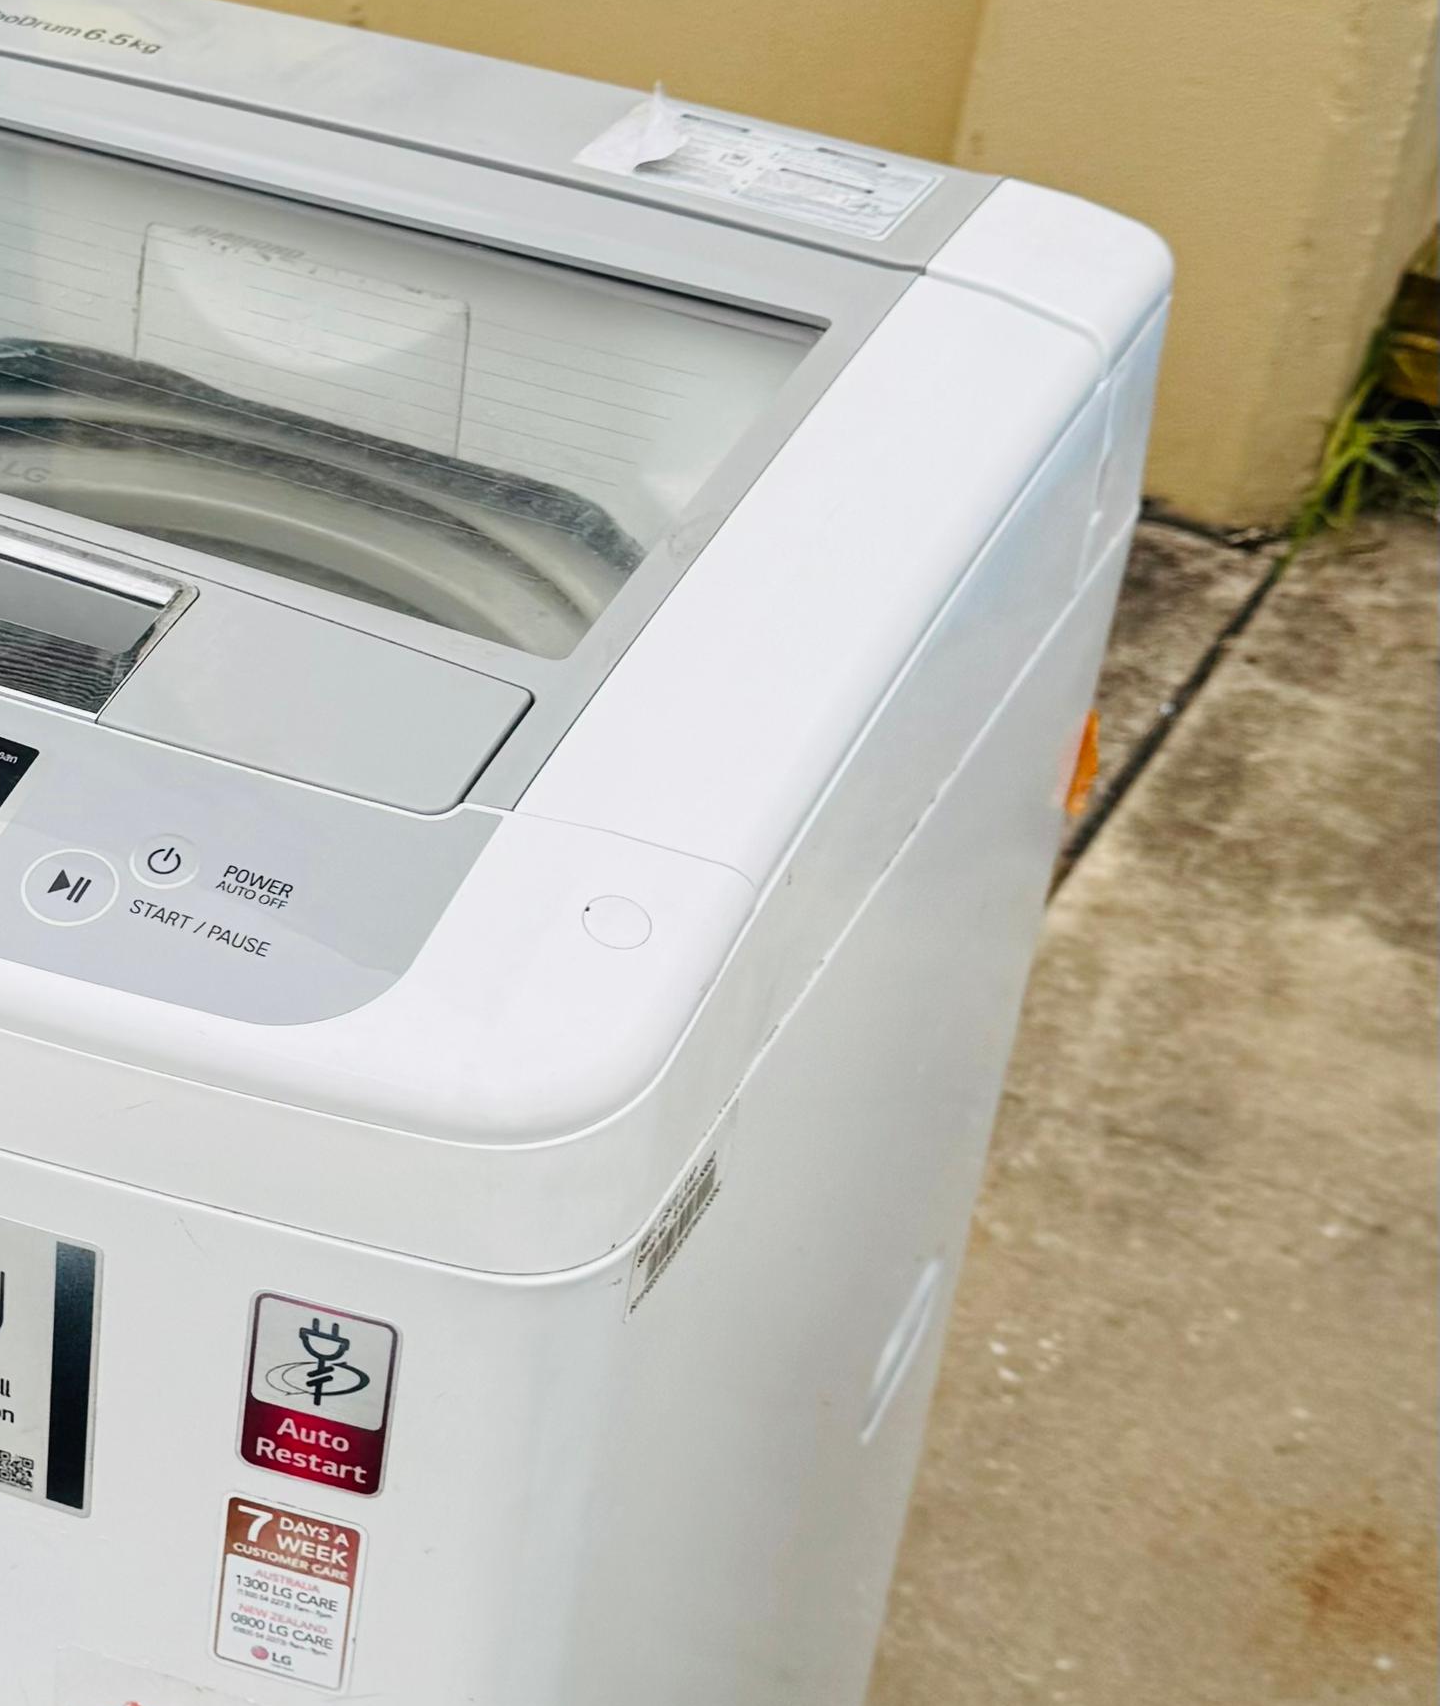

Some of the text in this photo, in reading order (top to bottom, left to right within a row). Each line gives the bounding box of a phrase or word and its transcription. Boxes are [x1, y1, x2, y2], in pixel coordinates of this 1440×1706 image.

[1, 460, 52, 483] LG
[215, 880, 288, 910] AUTO OFF
[222, 864, 295, 898] POWER
[129, 898, 194, 931] START
[206, 924, 272, 958] PAUSE
[276, 1417, 350, 1453] Auto
[255, 1436, 368, 1485] Restart
[237, 1504, 349, 1547] 7 DAYS A
[232, 1541, 349, 1582] CUSTOMER CARE
[276, 1533, 348, 1568] WEEK
[236, 1574, 269, 1592] 1300
[272, 1585, 293, 1600] LG
[296, 1591, 339, 1612] CARE
[231, 1612, 266, 1630] 0800
[268, 1623, 289, 1637] LG
[292, 1629, 334, 1650] CARE
[271, 1652, 292, 1666] LG
